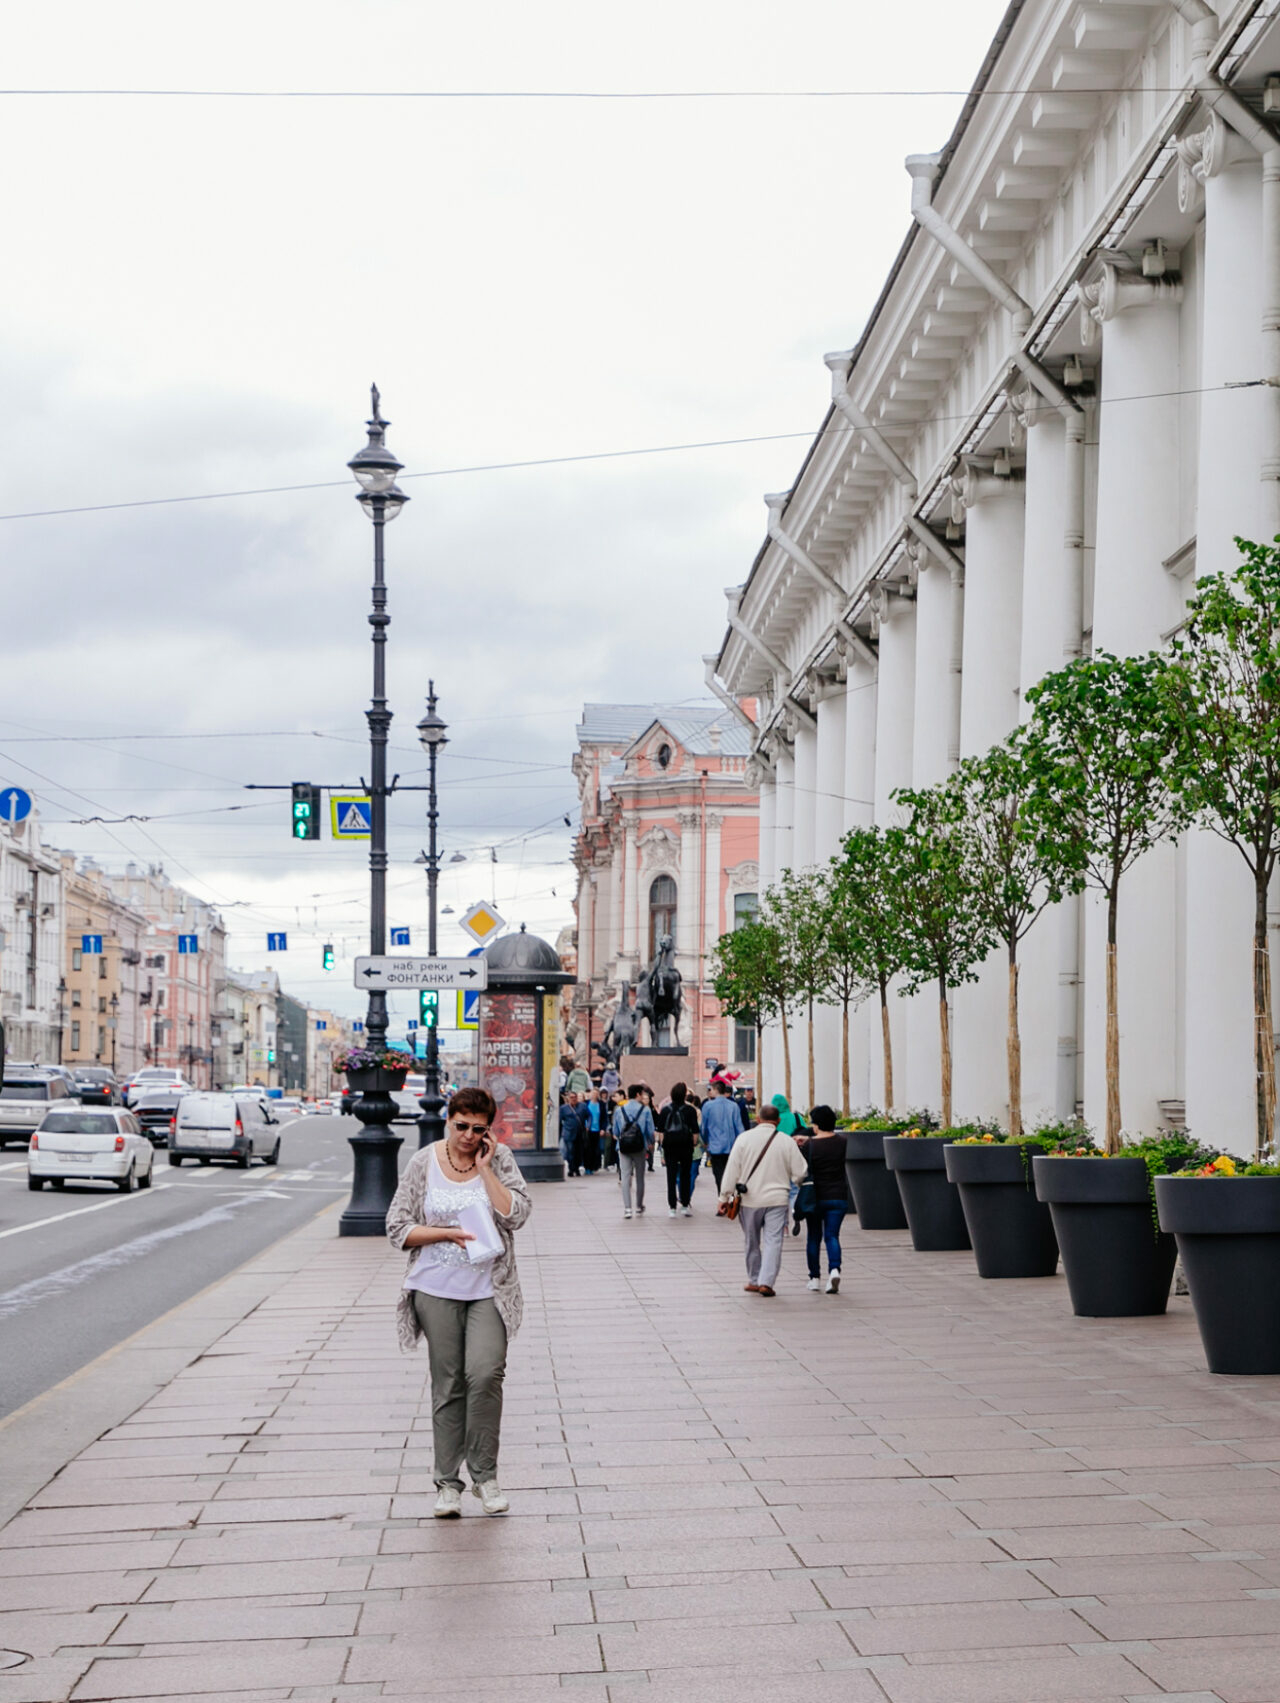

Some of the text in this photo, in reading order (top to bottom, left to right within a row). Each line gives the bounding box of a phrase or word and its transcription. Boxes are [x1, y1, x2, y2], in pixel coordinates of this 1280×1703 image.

[294, 803, 310, 818] 27
[420, 963, 447, 972] реки
[387, 974, 454, 983] ФОНТАНКИ
